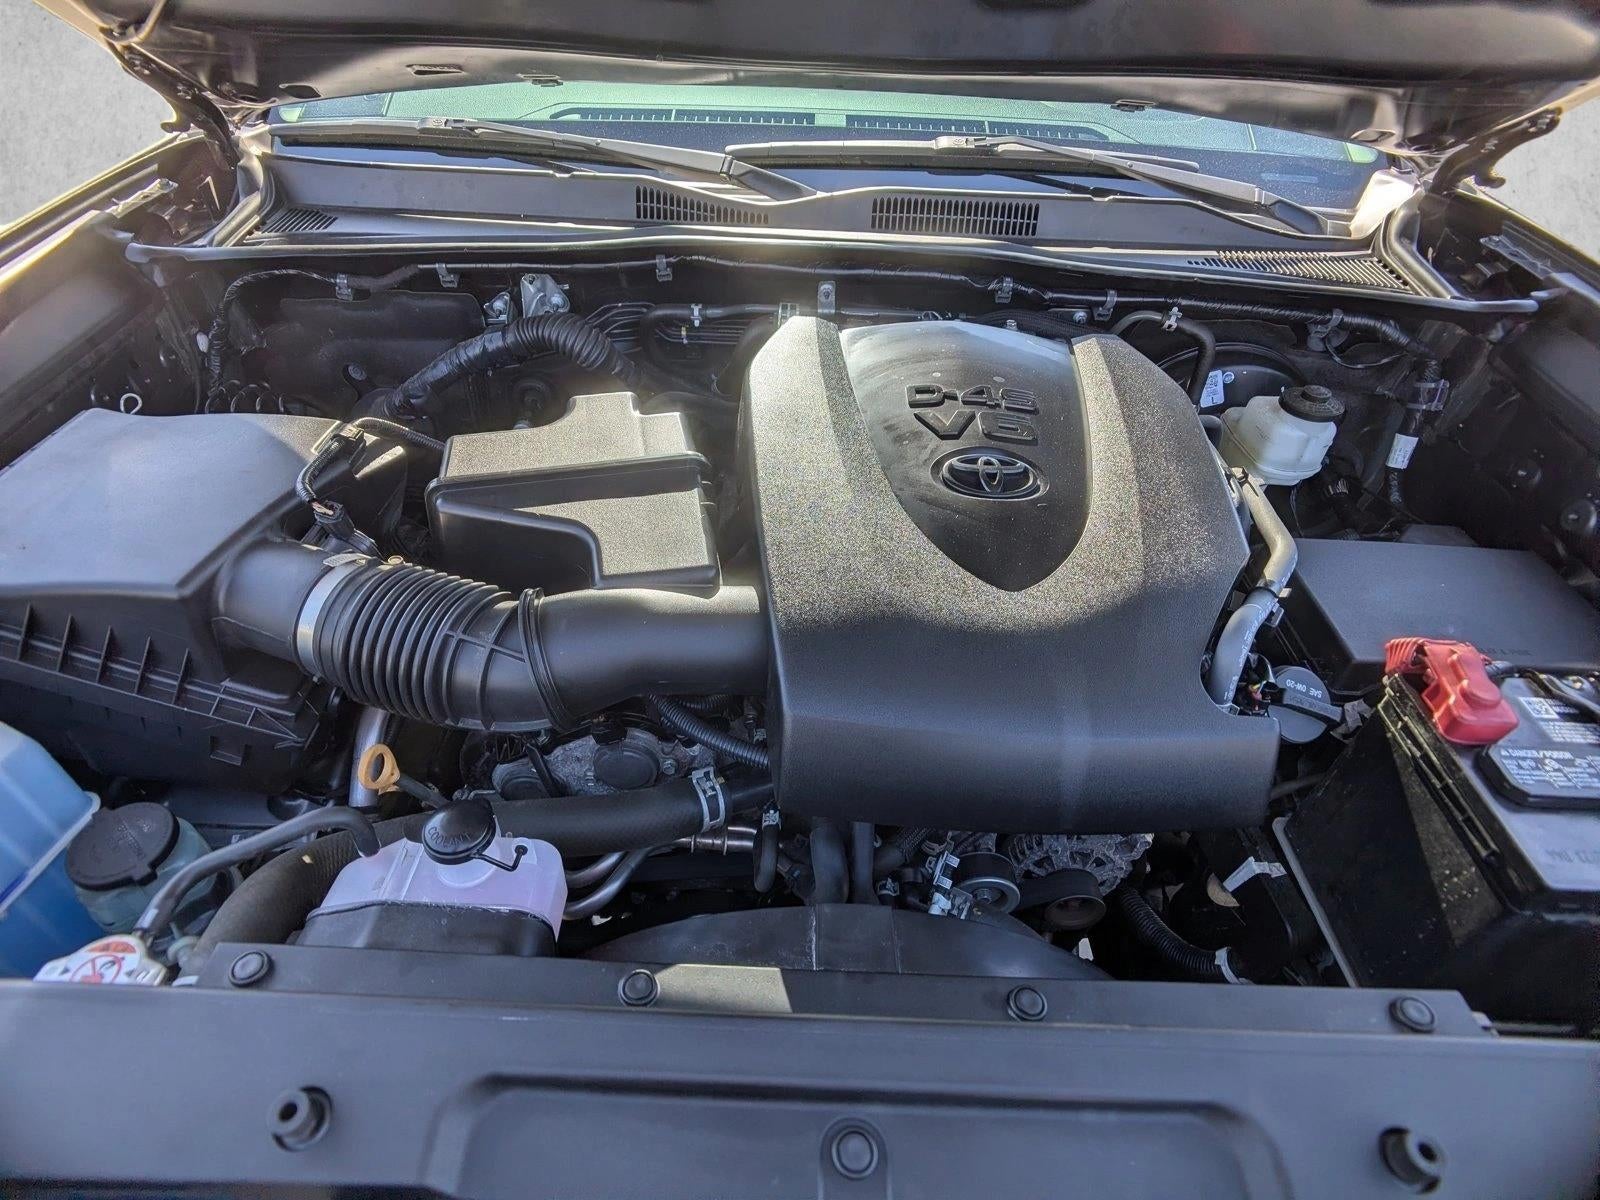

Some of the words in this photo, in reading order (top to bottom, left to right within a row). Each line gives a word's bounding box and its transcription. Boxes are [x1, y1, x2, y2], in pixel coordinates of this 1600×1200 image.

[913, 410, 1038, 446] V6
[1285, 678, 1307, 693] 0W-20
[1309, 687, 1323, 699] SAE
[427, 826, 474, 848] COOLANT
